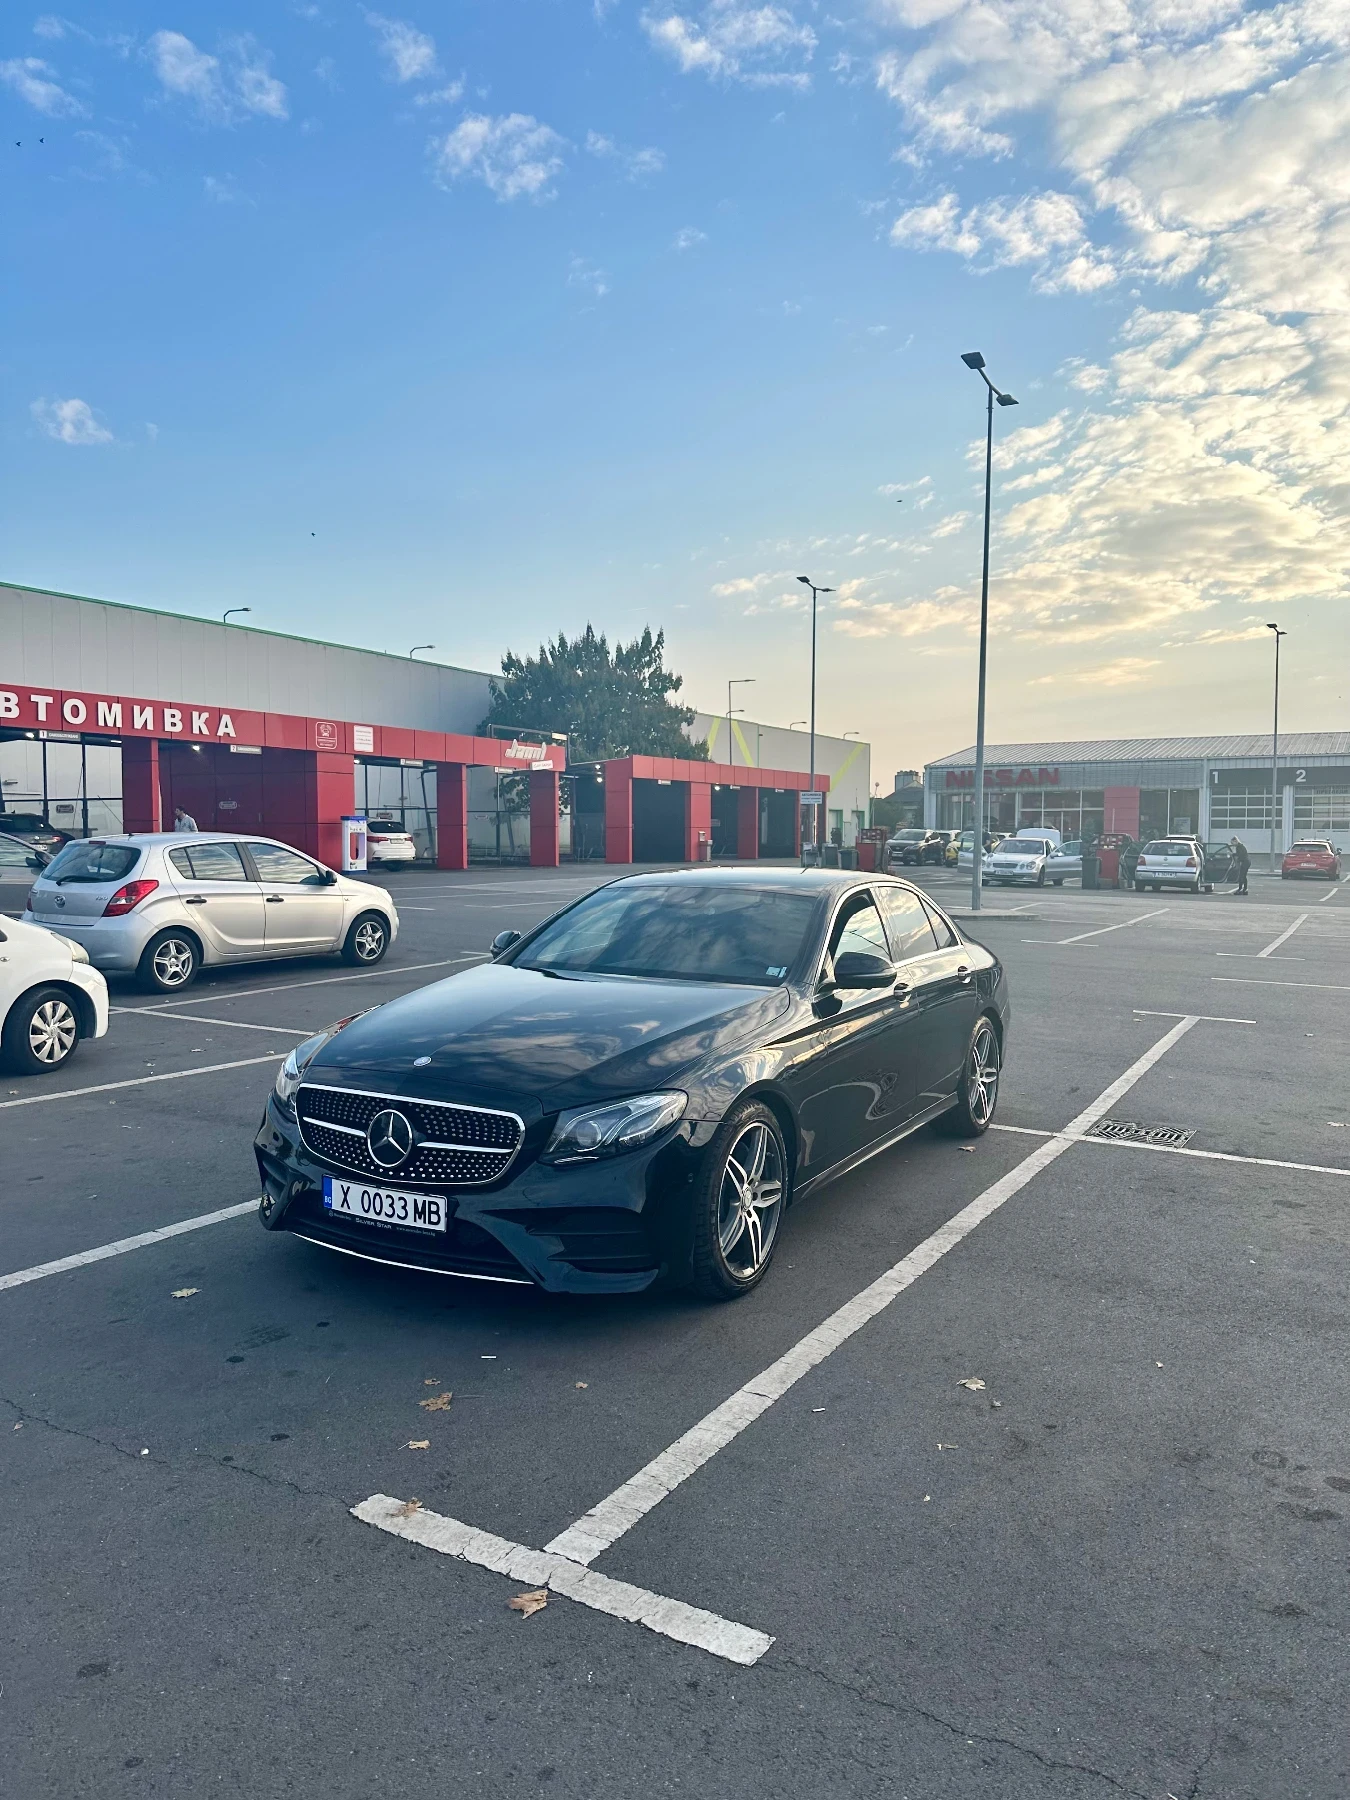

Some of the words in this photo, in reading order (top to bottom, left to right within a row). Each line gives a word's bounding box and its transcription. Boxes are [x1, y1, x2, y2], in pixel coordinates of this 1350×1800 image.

[1212, 771, 1219, 784] 1
[1295, 769, 1307, 783] 2
[324, 1195, 332, 1204] BG
[361, 1189, 409, 1221] 0033
[413, 1197, 442, 1226] MB
